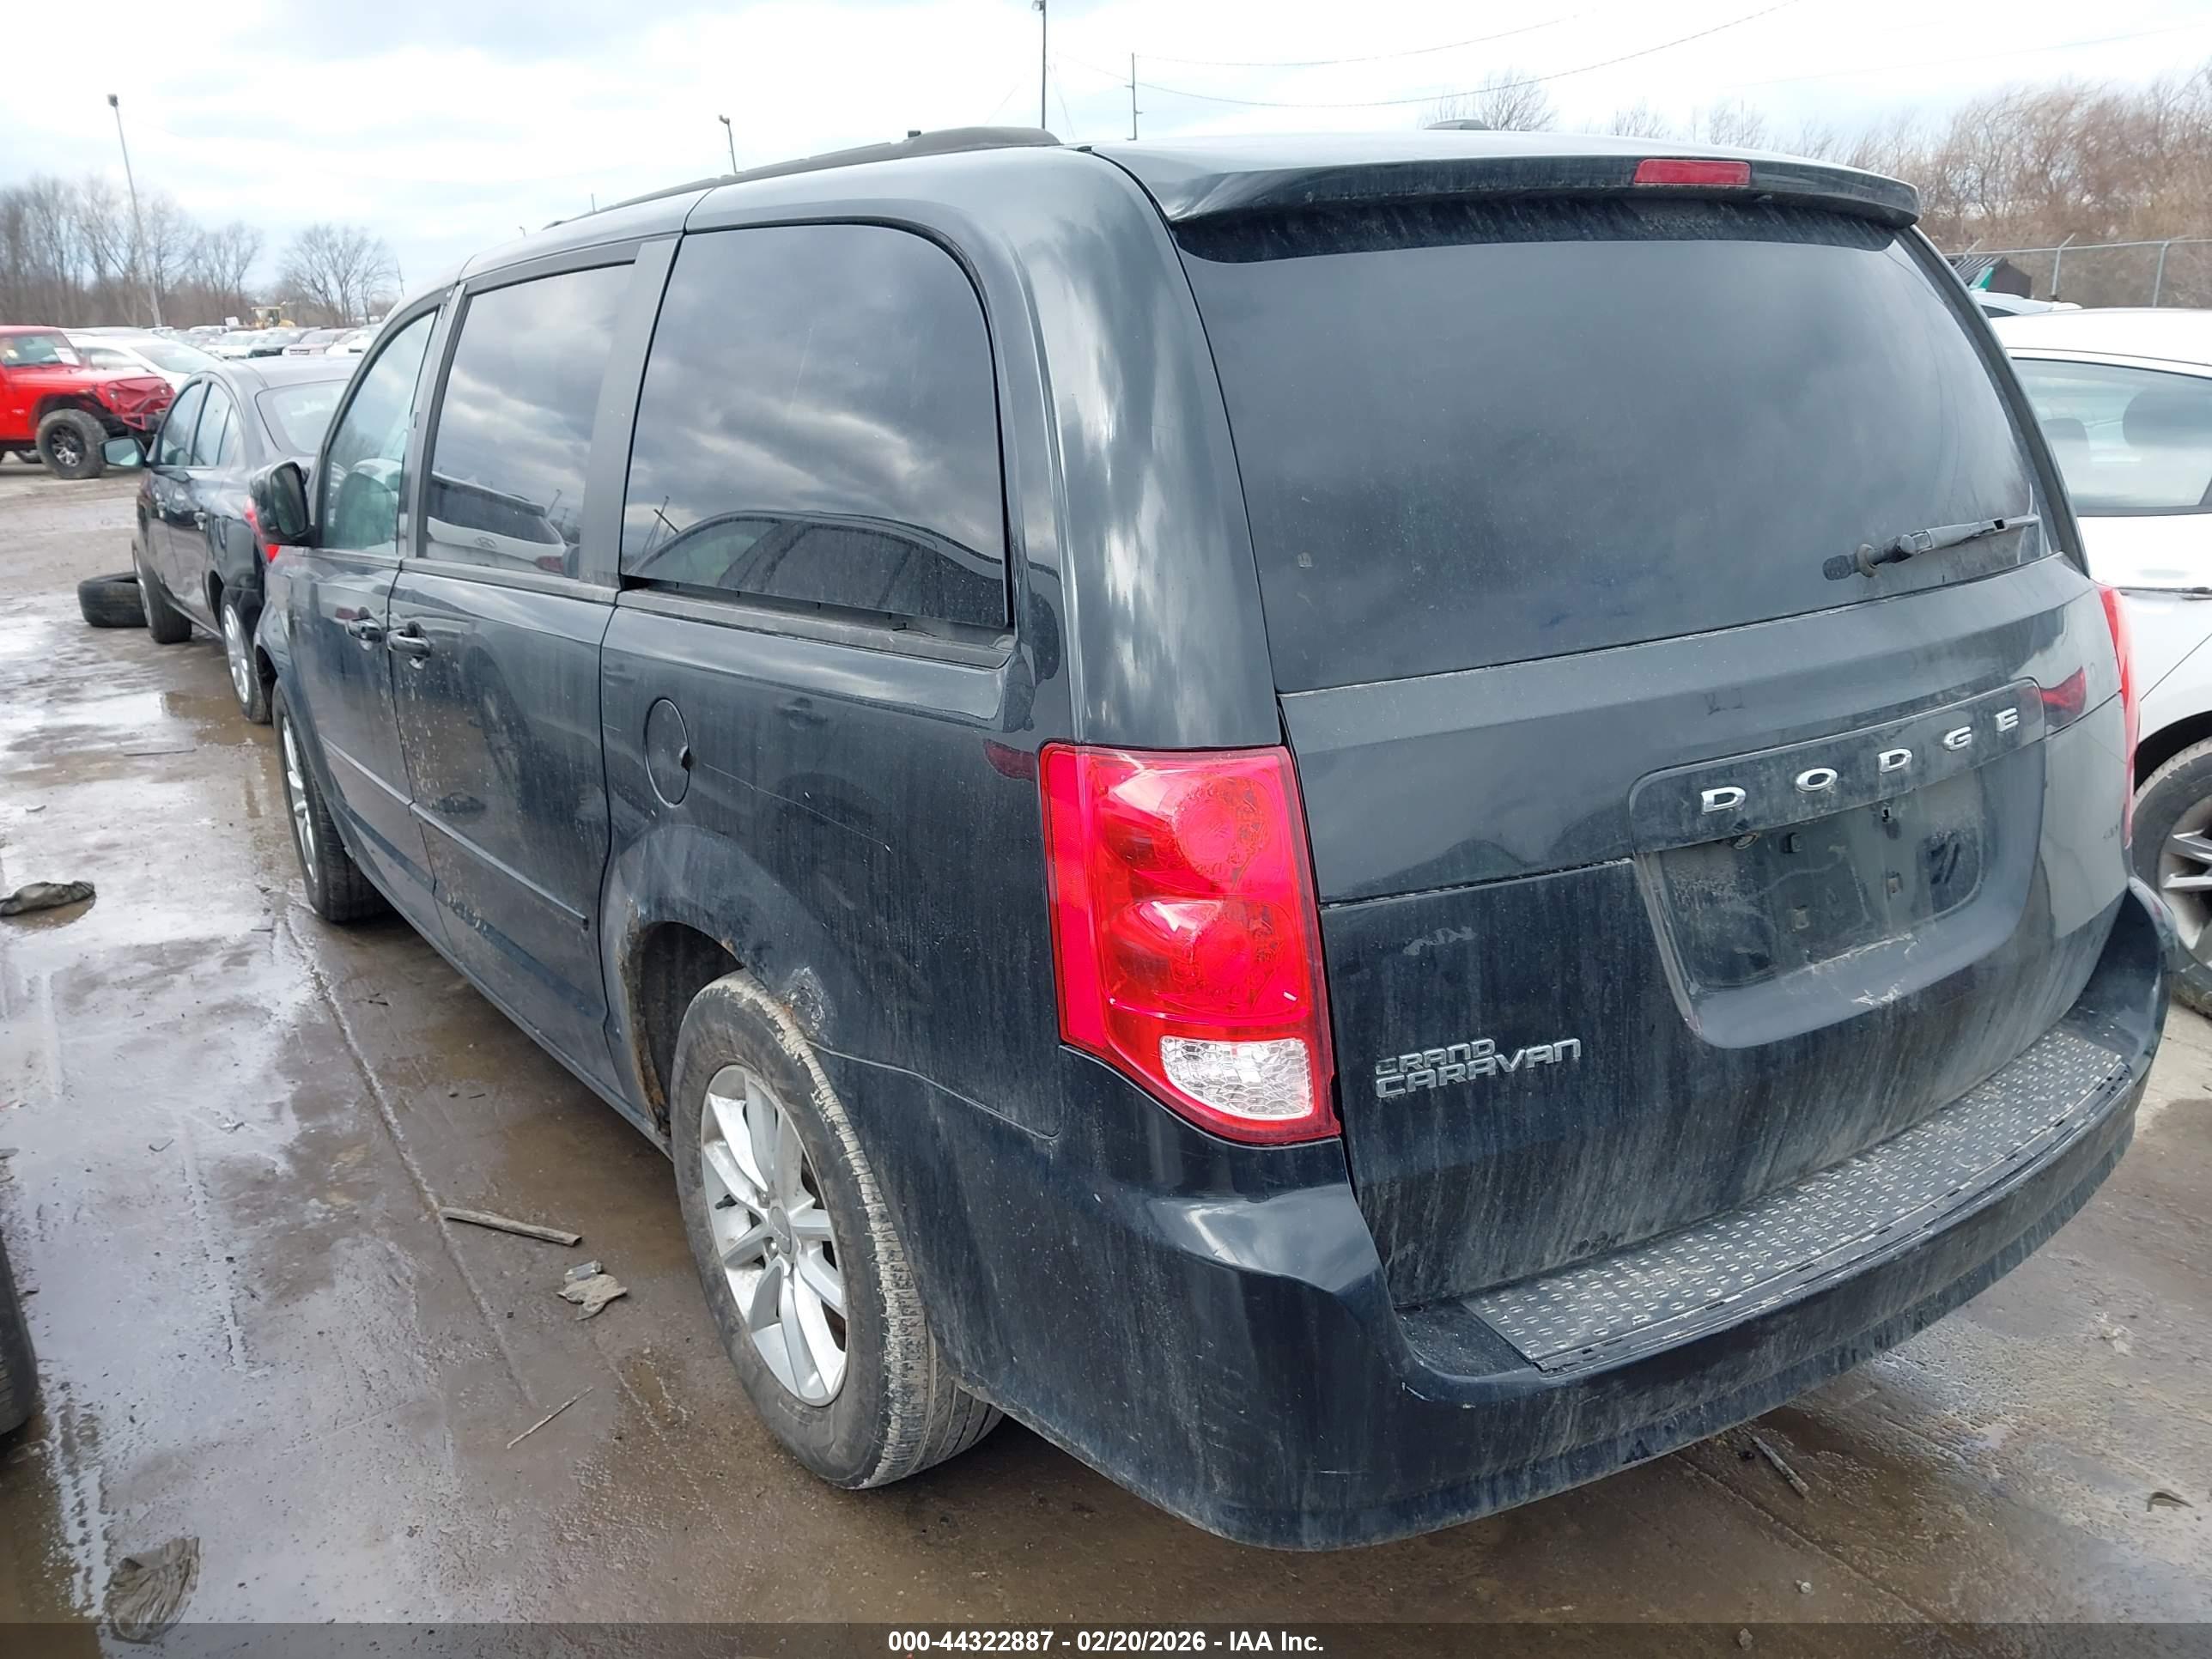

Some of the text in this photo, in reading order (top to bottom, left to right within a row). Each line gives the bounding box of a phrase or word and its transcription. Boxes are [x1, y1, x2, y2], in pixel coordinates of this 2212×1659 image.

[1700, 707, 2020, 814] DODGE
[1375, 1038, 1496, 1075] GRAND
[1376, 1038, 1582, 1098] CARAVAN
